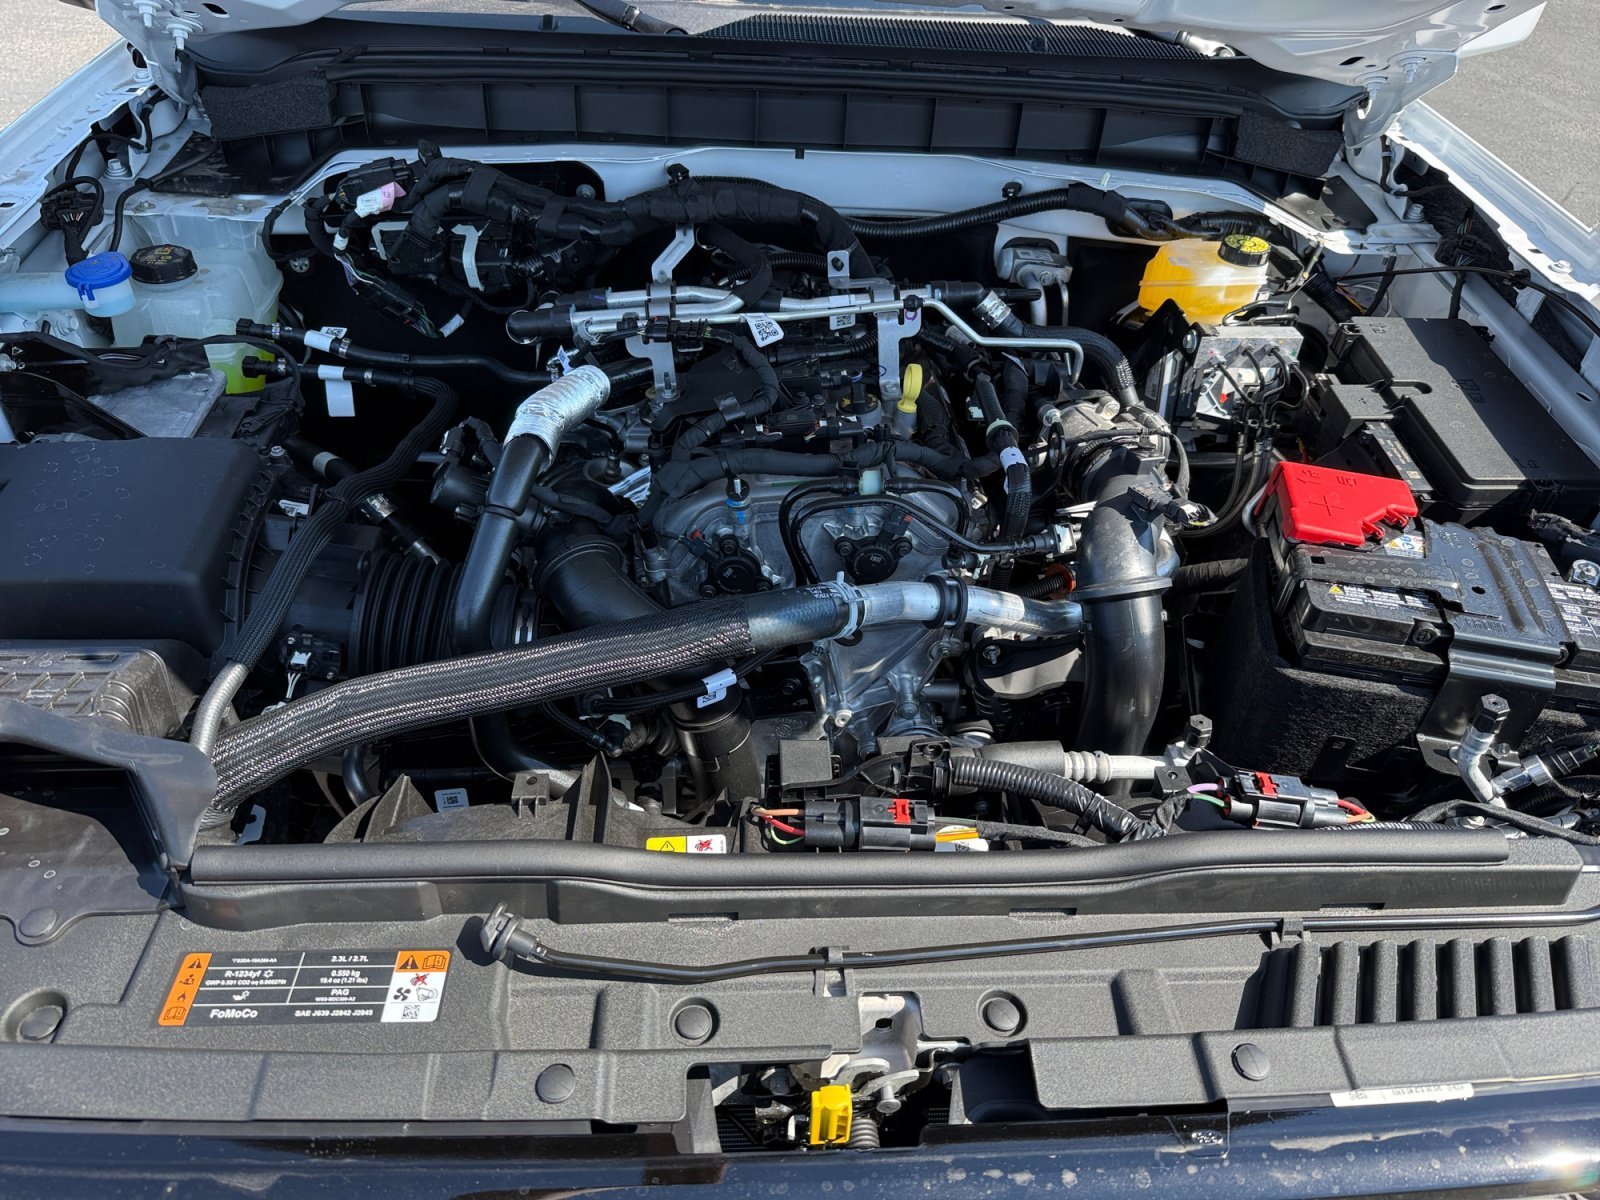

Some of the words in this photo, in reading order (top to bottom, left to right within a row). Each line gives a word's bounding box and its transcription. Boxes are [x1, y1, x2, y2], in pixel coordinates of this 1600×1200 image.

[330, 955, 347, 963] 2.3L
[224, 969, 262, 979] R-1234yf
[330, 969, 351, 977] 0.550
[351, 969, 361, 978] kg
[330, 988, 350, 996] PAG
[209, 1008, 258, 1019] FoMoCo
[294, 1009, 311, 1017] SAE
[311, 1009, 330, 1017] J639
